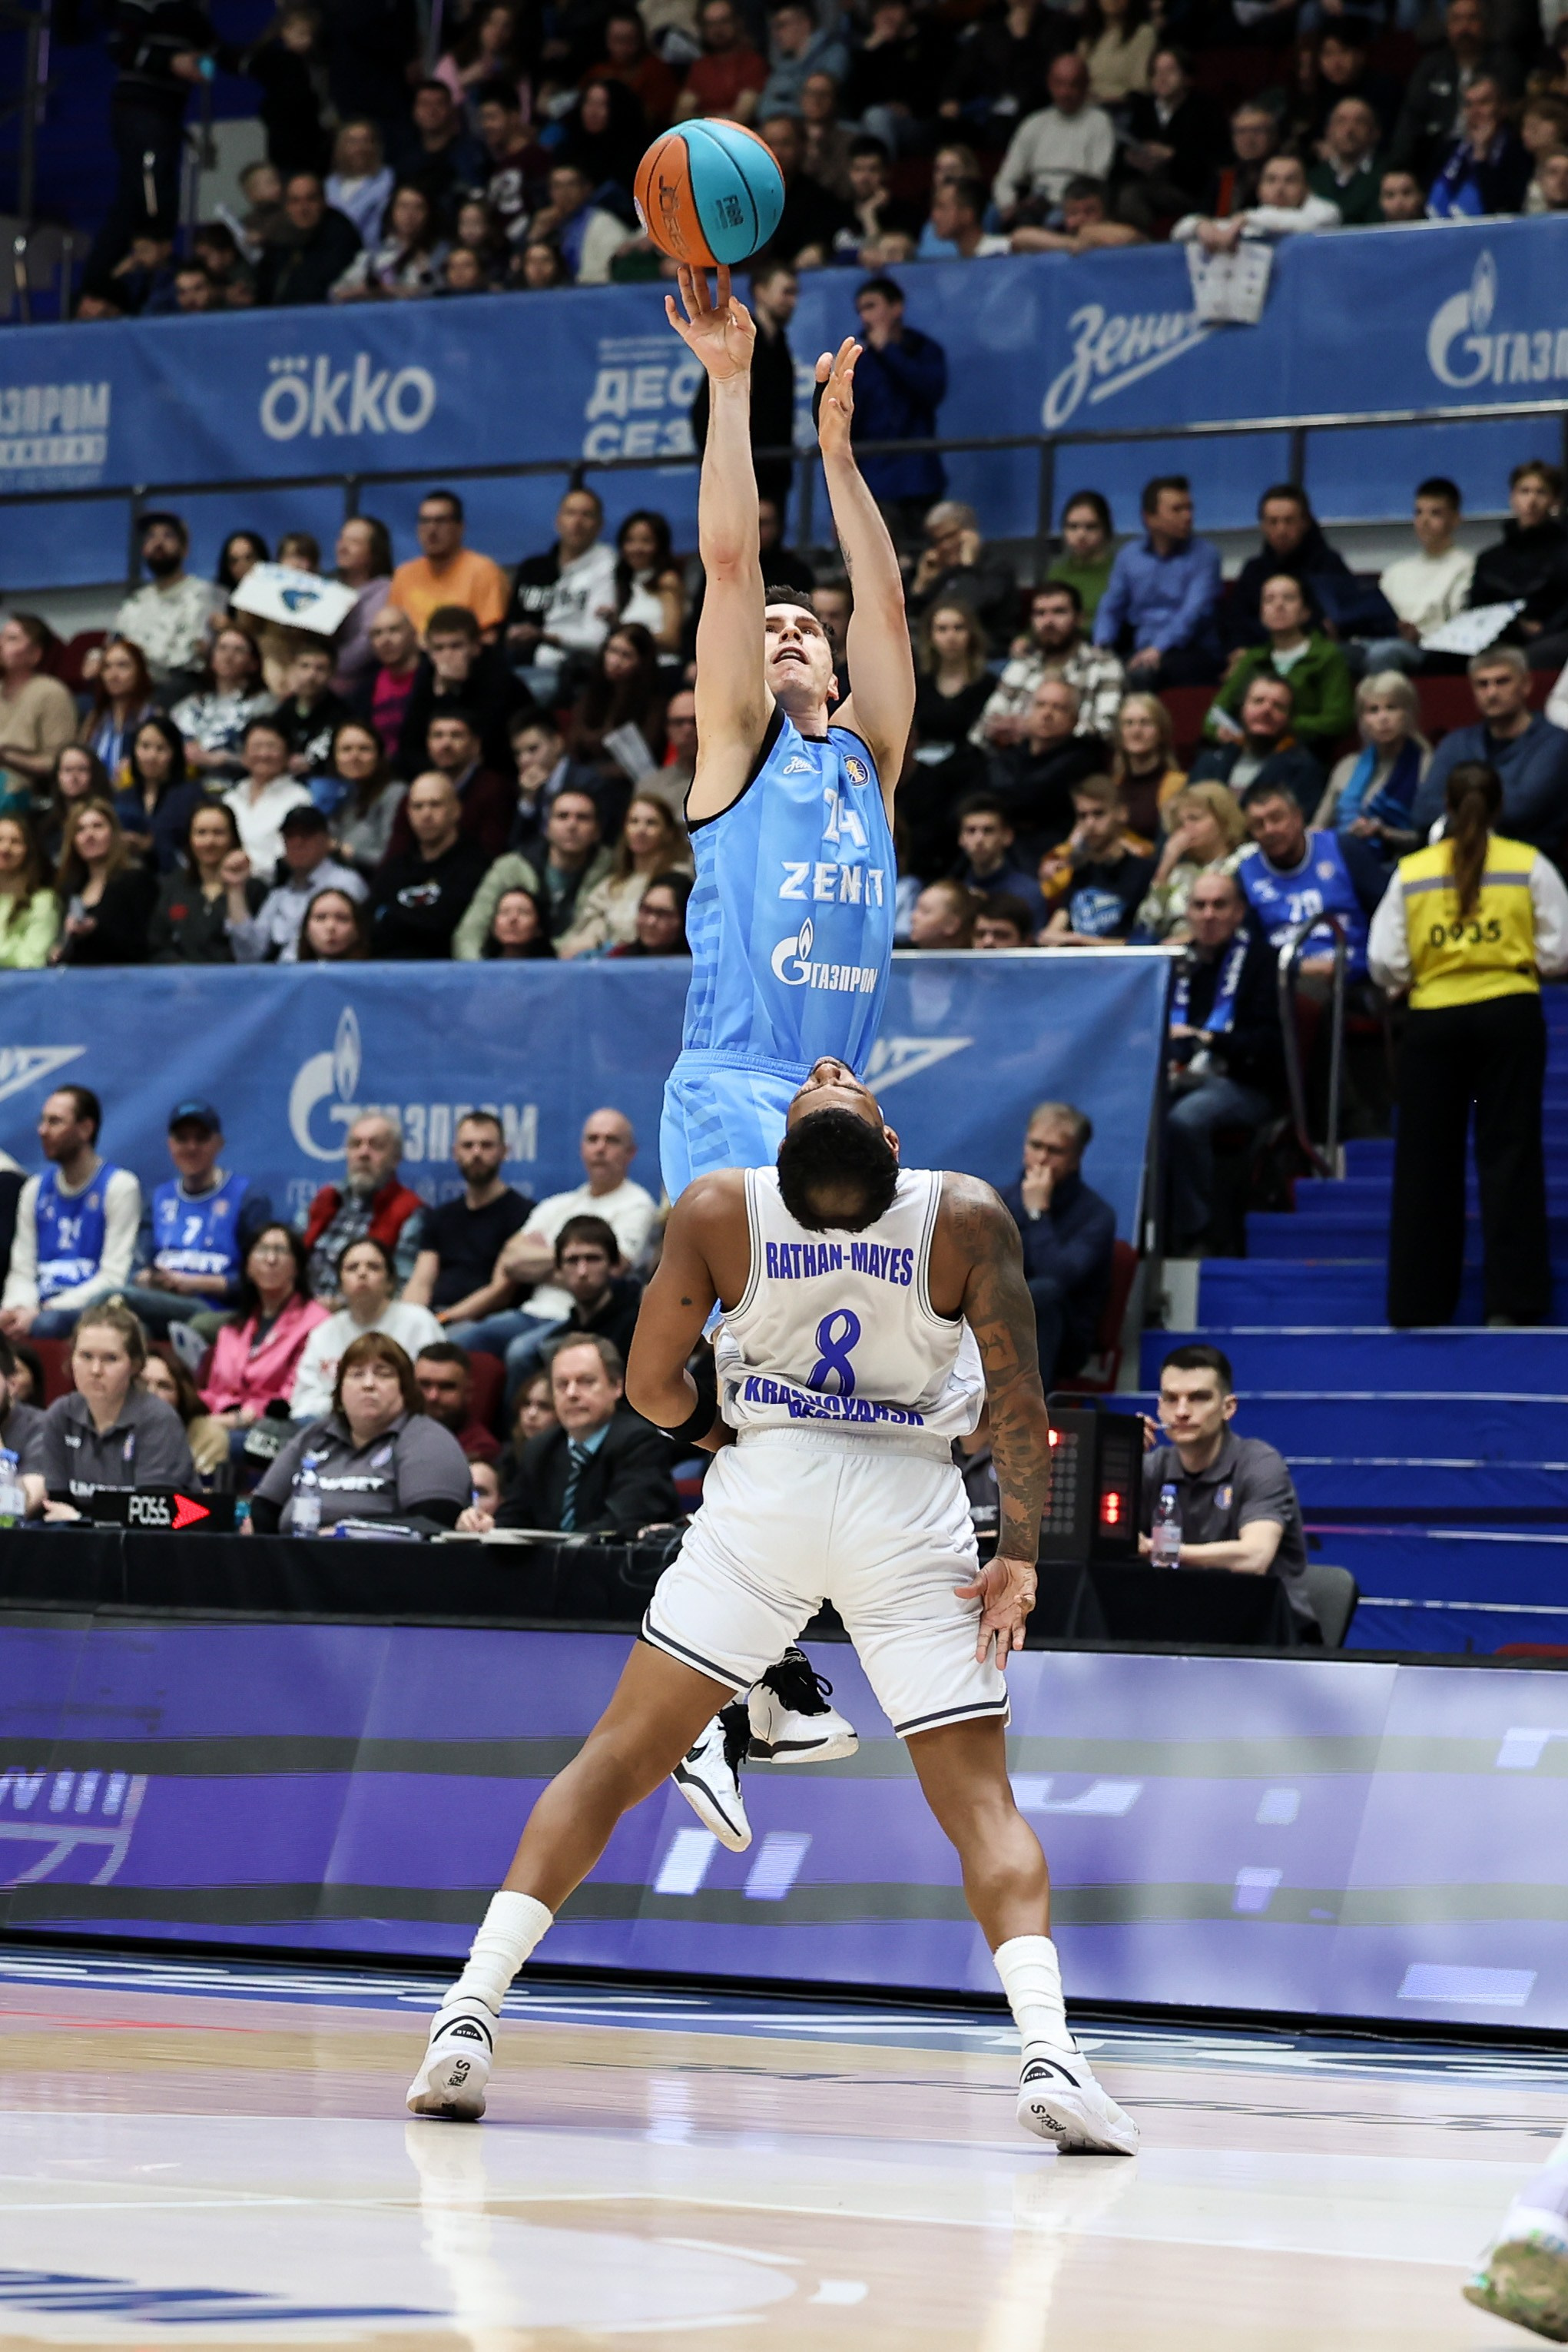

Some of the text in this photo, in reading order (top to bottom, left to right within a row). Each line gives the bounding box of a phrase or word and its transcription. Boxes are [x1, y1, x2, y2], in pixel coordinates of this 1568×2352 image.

[1043, 304, 1208, 430] Зени
[0, 383, 111, 433] ЗПРОМ
[765, 1242, 914, 1287] RATHAN-MAYES
[807, 1309, 861, 1398] 8
